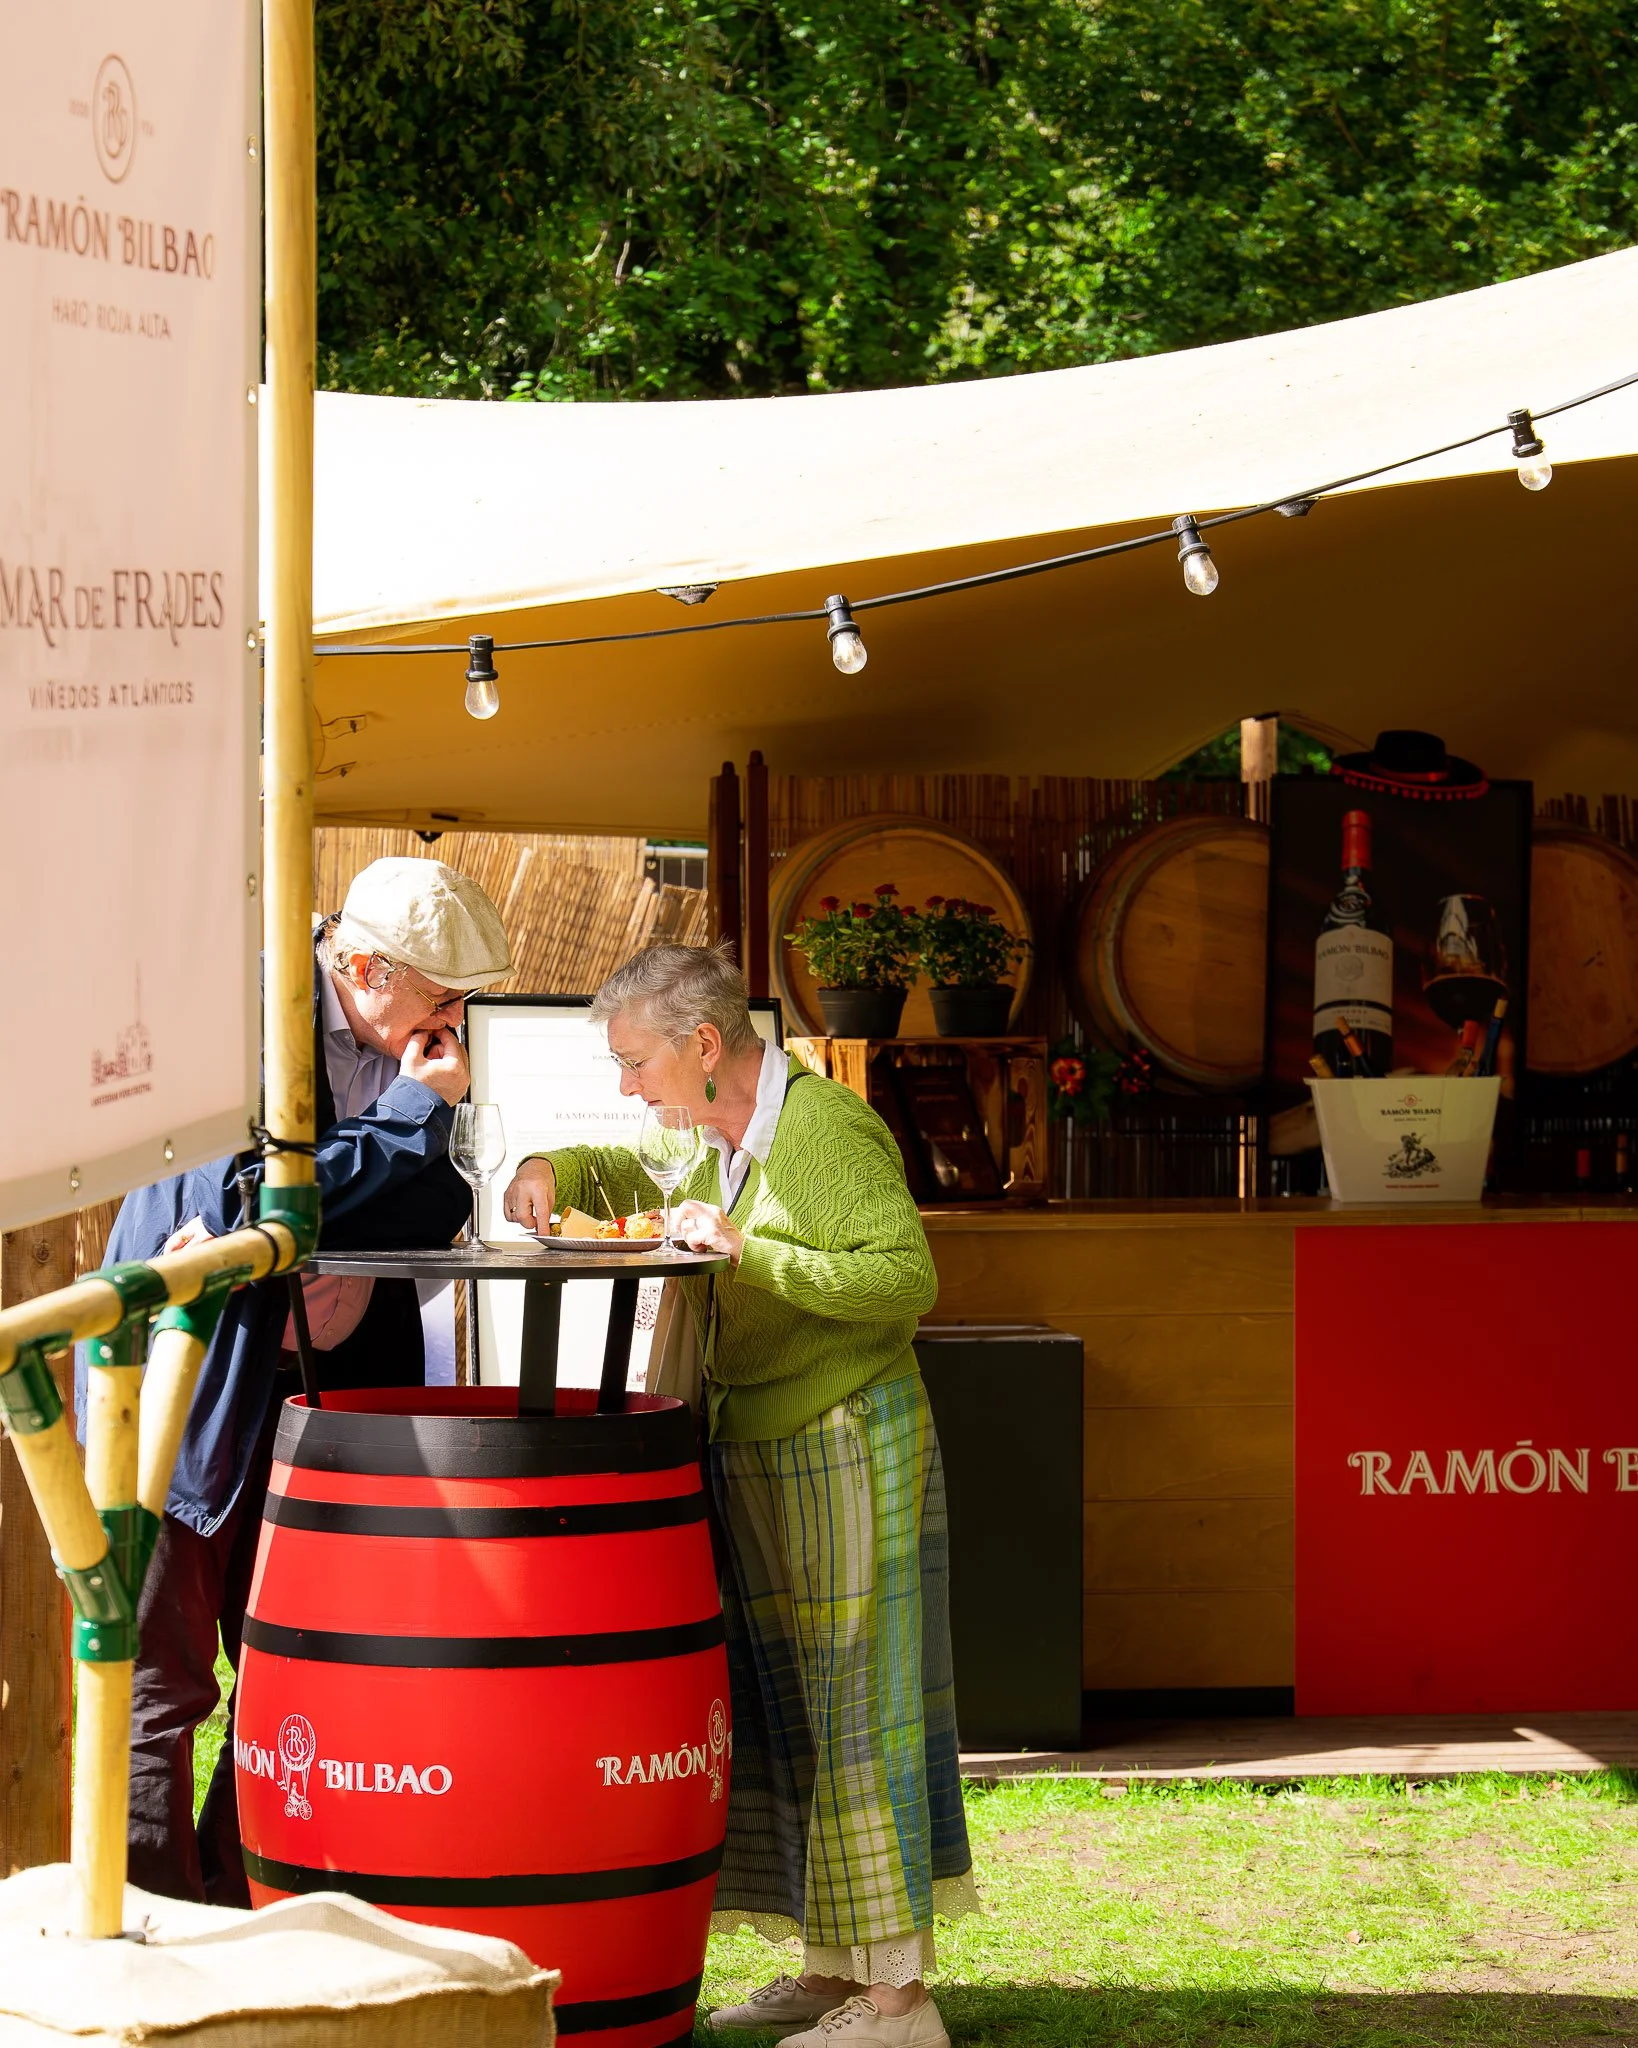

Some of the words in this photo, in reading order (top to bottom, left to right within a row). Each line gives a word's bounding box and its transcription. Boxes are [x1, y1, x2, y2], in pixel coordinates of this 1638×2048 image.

[0, 188, 111, 262] RAMÓN
[96, 303, 132, 334] RIOJA
[137, 311, 173, 341] ALTA
[0, 556, 68, 648] MAR
[74, 586, 106, 629] DE
[111, 569, 224, 647] FRADES
[29, 680, 101, 710] VIÑEDOS
[108, 677, 194, 707] ATLÁNTICOS
[1412, 1107, 1442, 1115] BILBAO
[1347, 1439, 1590, 1495] RAMÓN
[318, 1758, 453, 1795] BILBAO
[596, 1742, 707, 1788] RAMÓN
